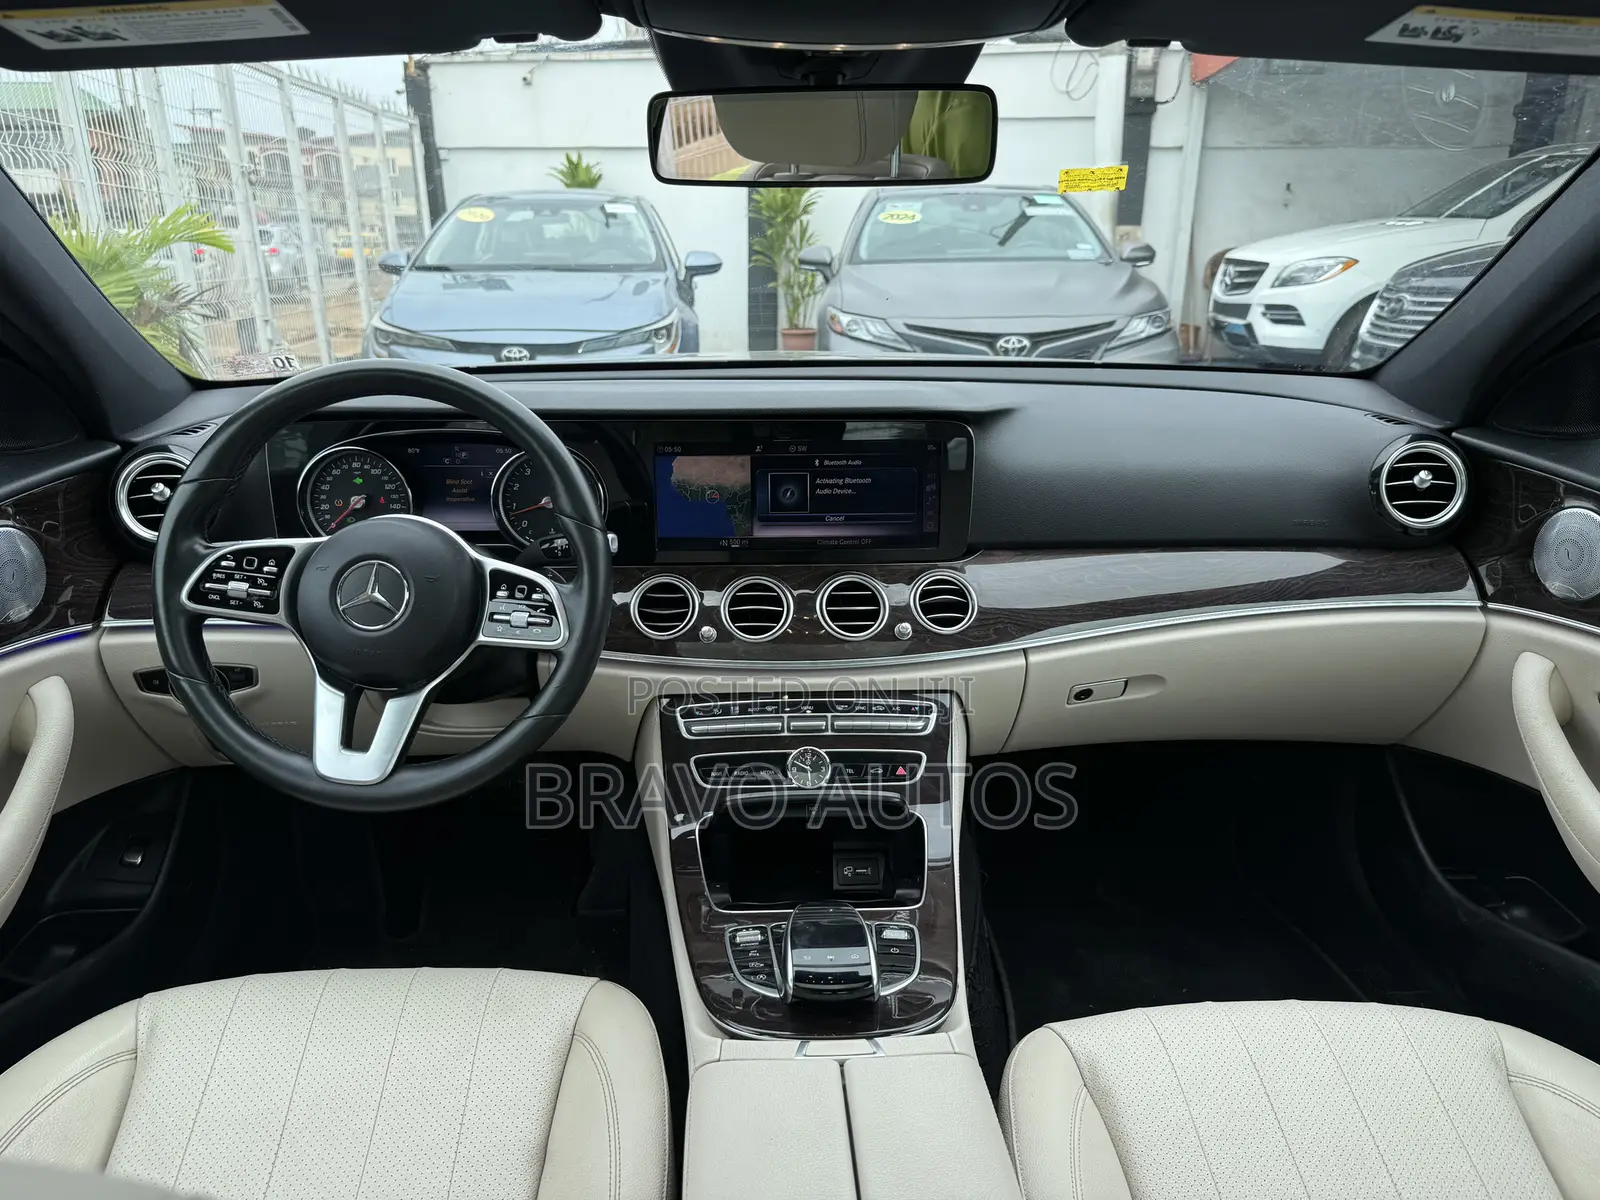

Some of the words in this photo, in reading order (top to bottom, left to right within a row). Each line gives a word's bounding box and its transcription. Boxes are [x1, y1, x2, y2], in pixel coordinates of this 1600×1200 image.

[524, 468, 531, 476] 3
[815, 477, 844, 485] Activating
[521, 520, 528, 528] 0
